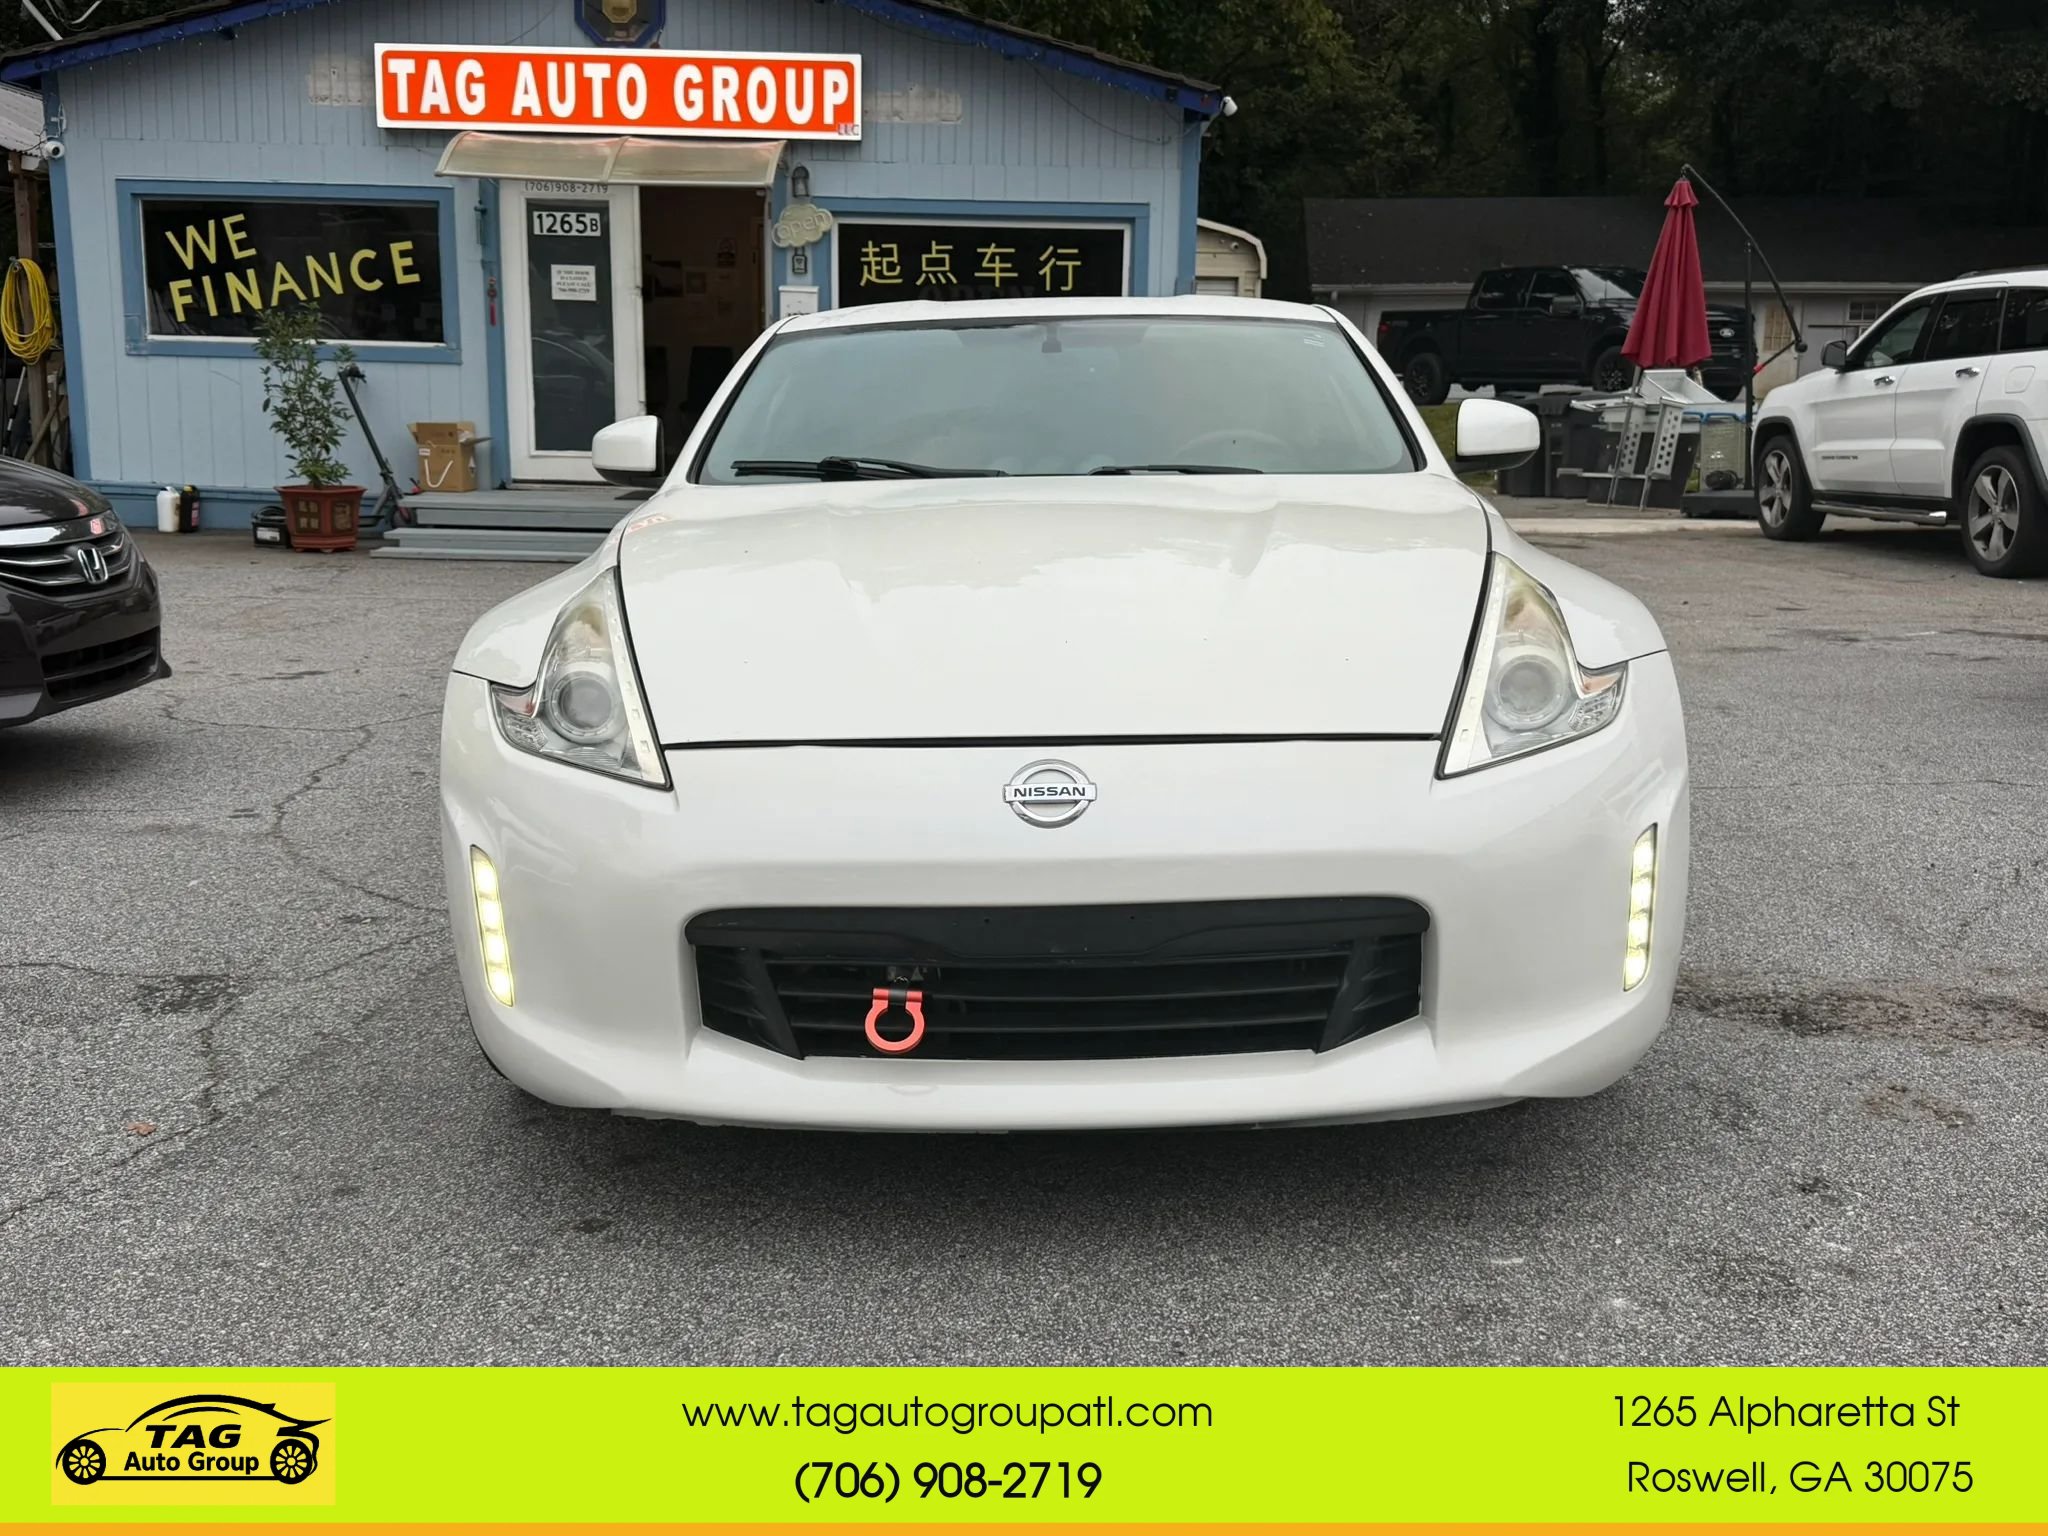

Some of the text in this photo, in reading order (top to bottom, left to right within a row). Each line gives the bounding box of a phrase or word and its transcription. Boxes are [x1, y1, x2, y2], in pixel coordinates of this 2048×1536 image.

[387, 58, 849, 126] TAG AUTO GROUP
[838, 123, 860, 136] LLC
[524, 181, 609, 194] (706)908-2719
[165, 213, 257, 271] WE
[860, 240, 1082, 292] 起点车行
[169, 240, 421, 323] FINANCE
[1013, 786, 1086, 797] NISSAN
